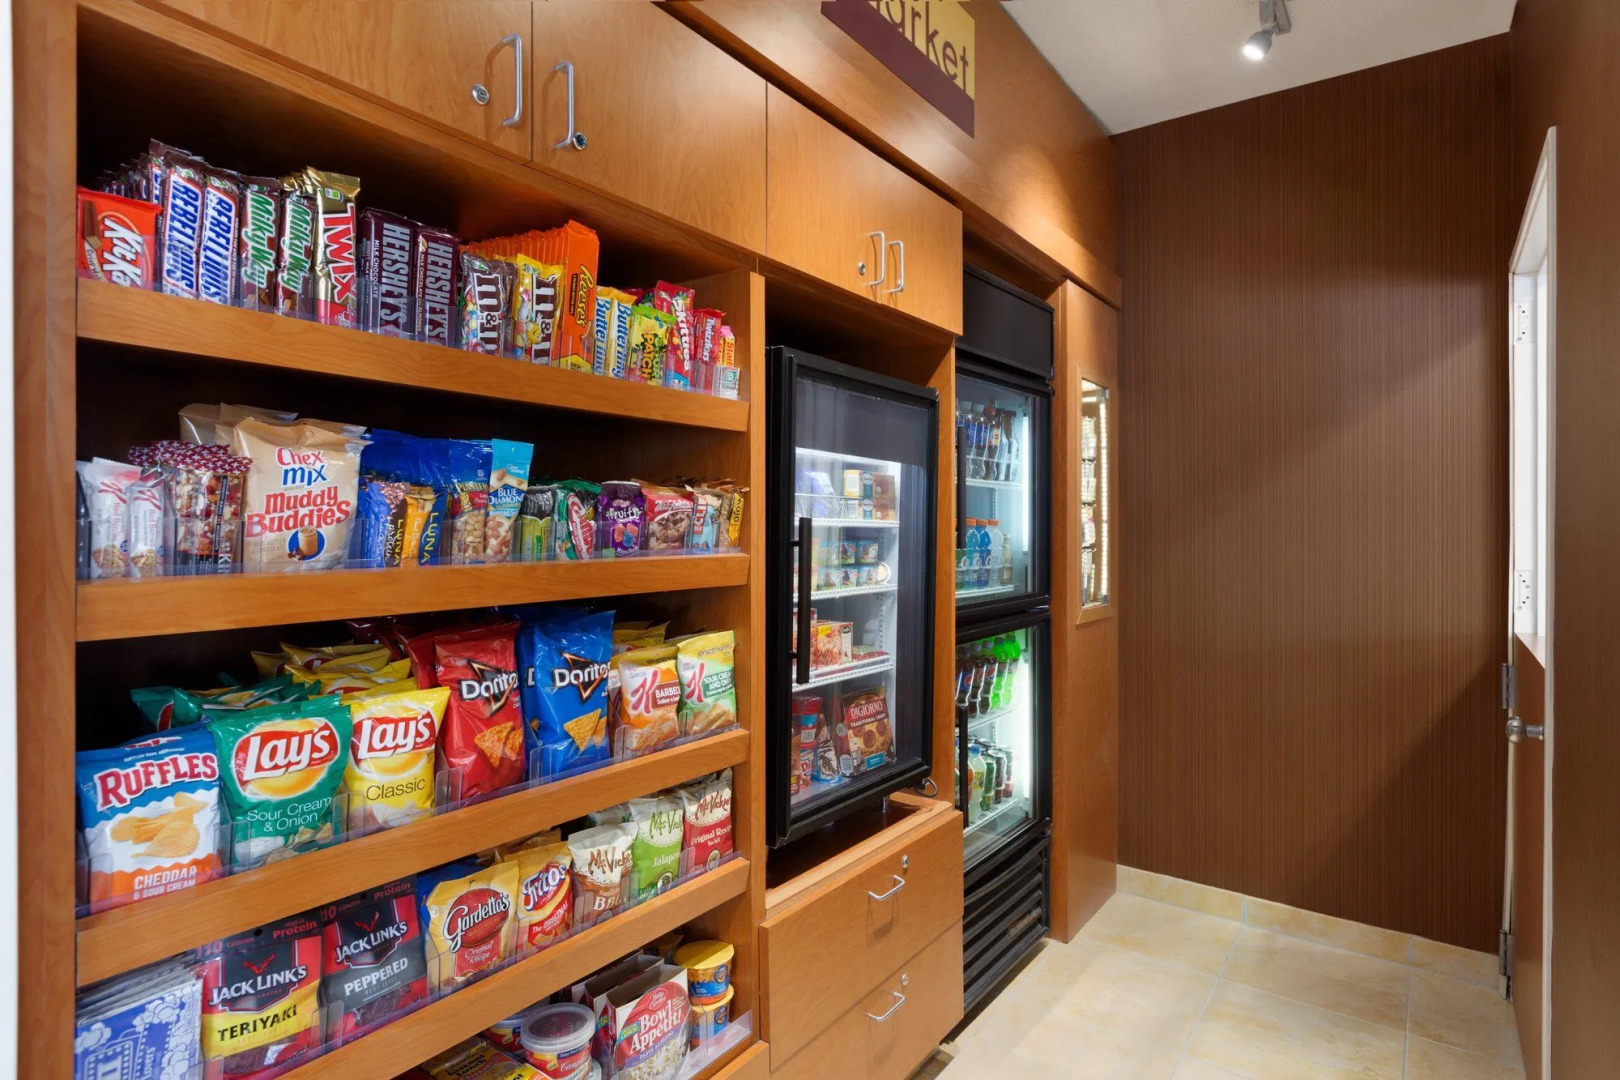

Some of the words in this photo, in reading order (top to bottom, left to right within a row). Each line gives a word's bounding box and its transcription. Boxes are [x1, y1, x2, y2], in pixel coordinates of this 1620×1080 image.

[873, 0, 968, 91] arket
[241, 191, 274, 247] Milky
[282, 200, 311, 257] Milky
[101, 218, 145, 287] KitKa
[243, 246, 275, 288] Way
[322, 203, 357, 302] TWIX
[279, 253, 309, 294] Way
[380, 222, 411, 324] HERSHEY'S
[424, 241, 453, 339] HERSHEY'S
[473, 273, 504, 354] m&m
[575, 265, 595, 328] Reese's
[532, 274, 558, 364] m&m
[611, 301, 632, 378] Butterfing
[641, 333, 654, 380] PATCH
[702, 316, 716, 362] Twizzlers
[275, 446, 326, 467] Chex
[281, 464, 328, 487] mix
[264, 485, 339, 515] muddy
[457, 482, 488, 492] PLANTER
[497, 487, 518, 497] BLUE
[245, 500, 351, 538] Buddies
[421, 512, 439, 564] LUNA
[384, 523, 396, 562] protein
[393, 519, 404, 565] LUNA
[460, 671, 519, 700] Dorito
[703, 675, 718, 685] SOUR
[850, 700, 883, 719] DIGIORNO
[243, 725, 331, 782] Lay's
[357, 714, 432, 760] Lay's
[95, 752, 220, 812] RUFFLES
[365, 777, 426, 801] Classic
[246, 807, 284, 823] Sour
[286, 796, 333, 817] Cream
[262, 821, 274, 833] &
[275, 812, 319, 832] Onion
[666, 808, 684, 834] Vick
[690, 829, 715, 846] Original
[132, 890, 140, 901] &
[142, 884, 165, 899] SOUR
[166, 878, 196, 894] CREAM
[133, 865, 198, 892] CHEDDAR
[373, 882, 411, 900] Protein
[272, 920, 317, 940] Protein
[335, 936, 373, 963] JACK
[369, 921, 409, 947] LINK'S
[442, 892, 511, 953] Gardetto's
[532, 925, 543, 934] The
[464, 939, 494, 959] Original
[208, 978, 256, 1006] JACK
[256, 965, 308, 991] LINK'S
[343, 957, 409, 997] PEPPERED
[217, 1004, 298, 1042] TERIYAKI
[638, 998, 673, 1036] Bowl
[639, 1047, 654, 1060] PASTA
